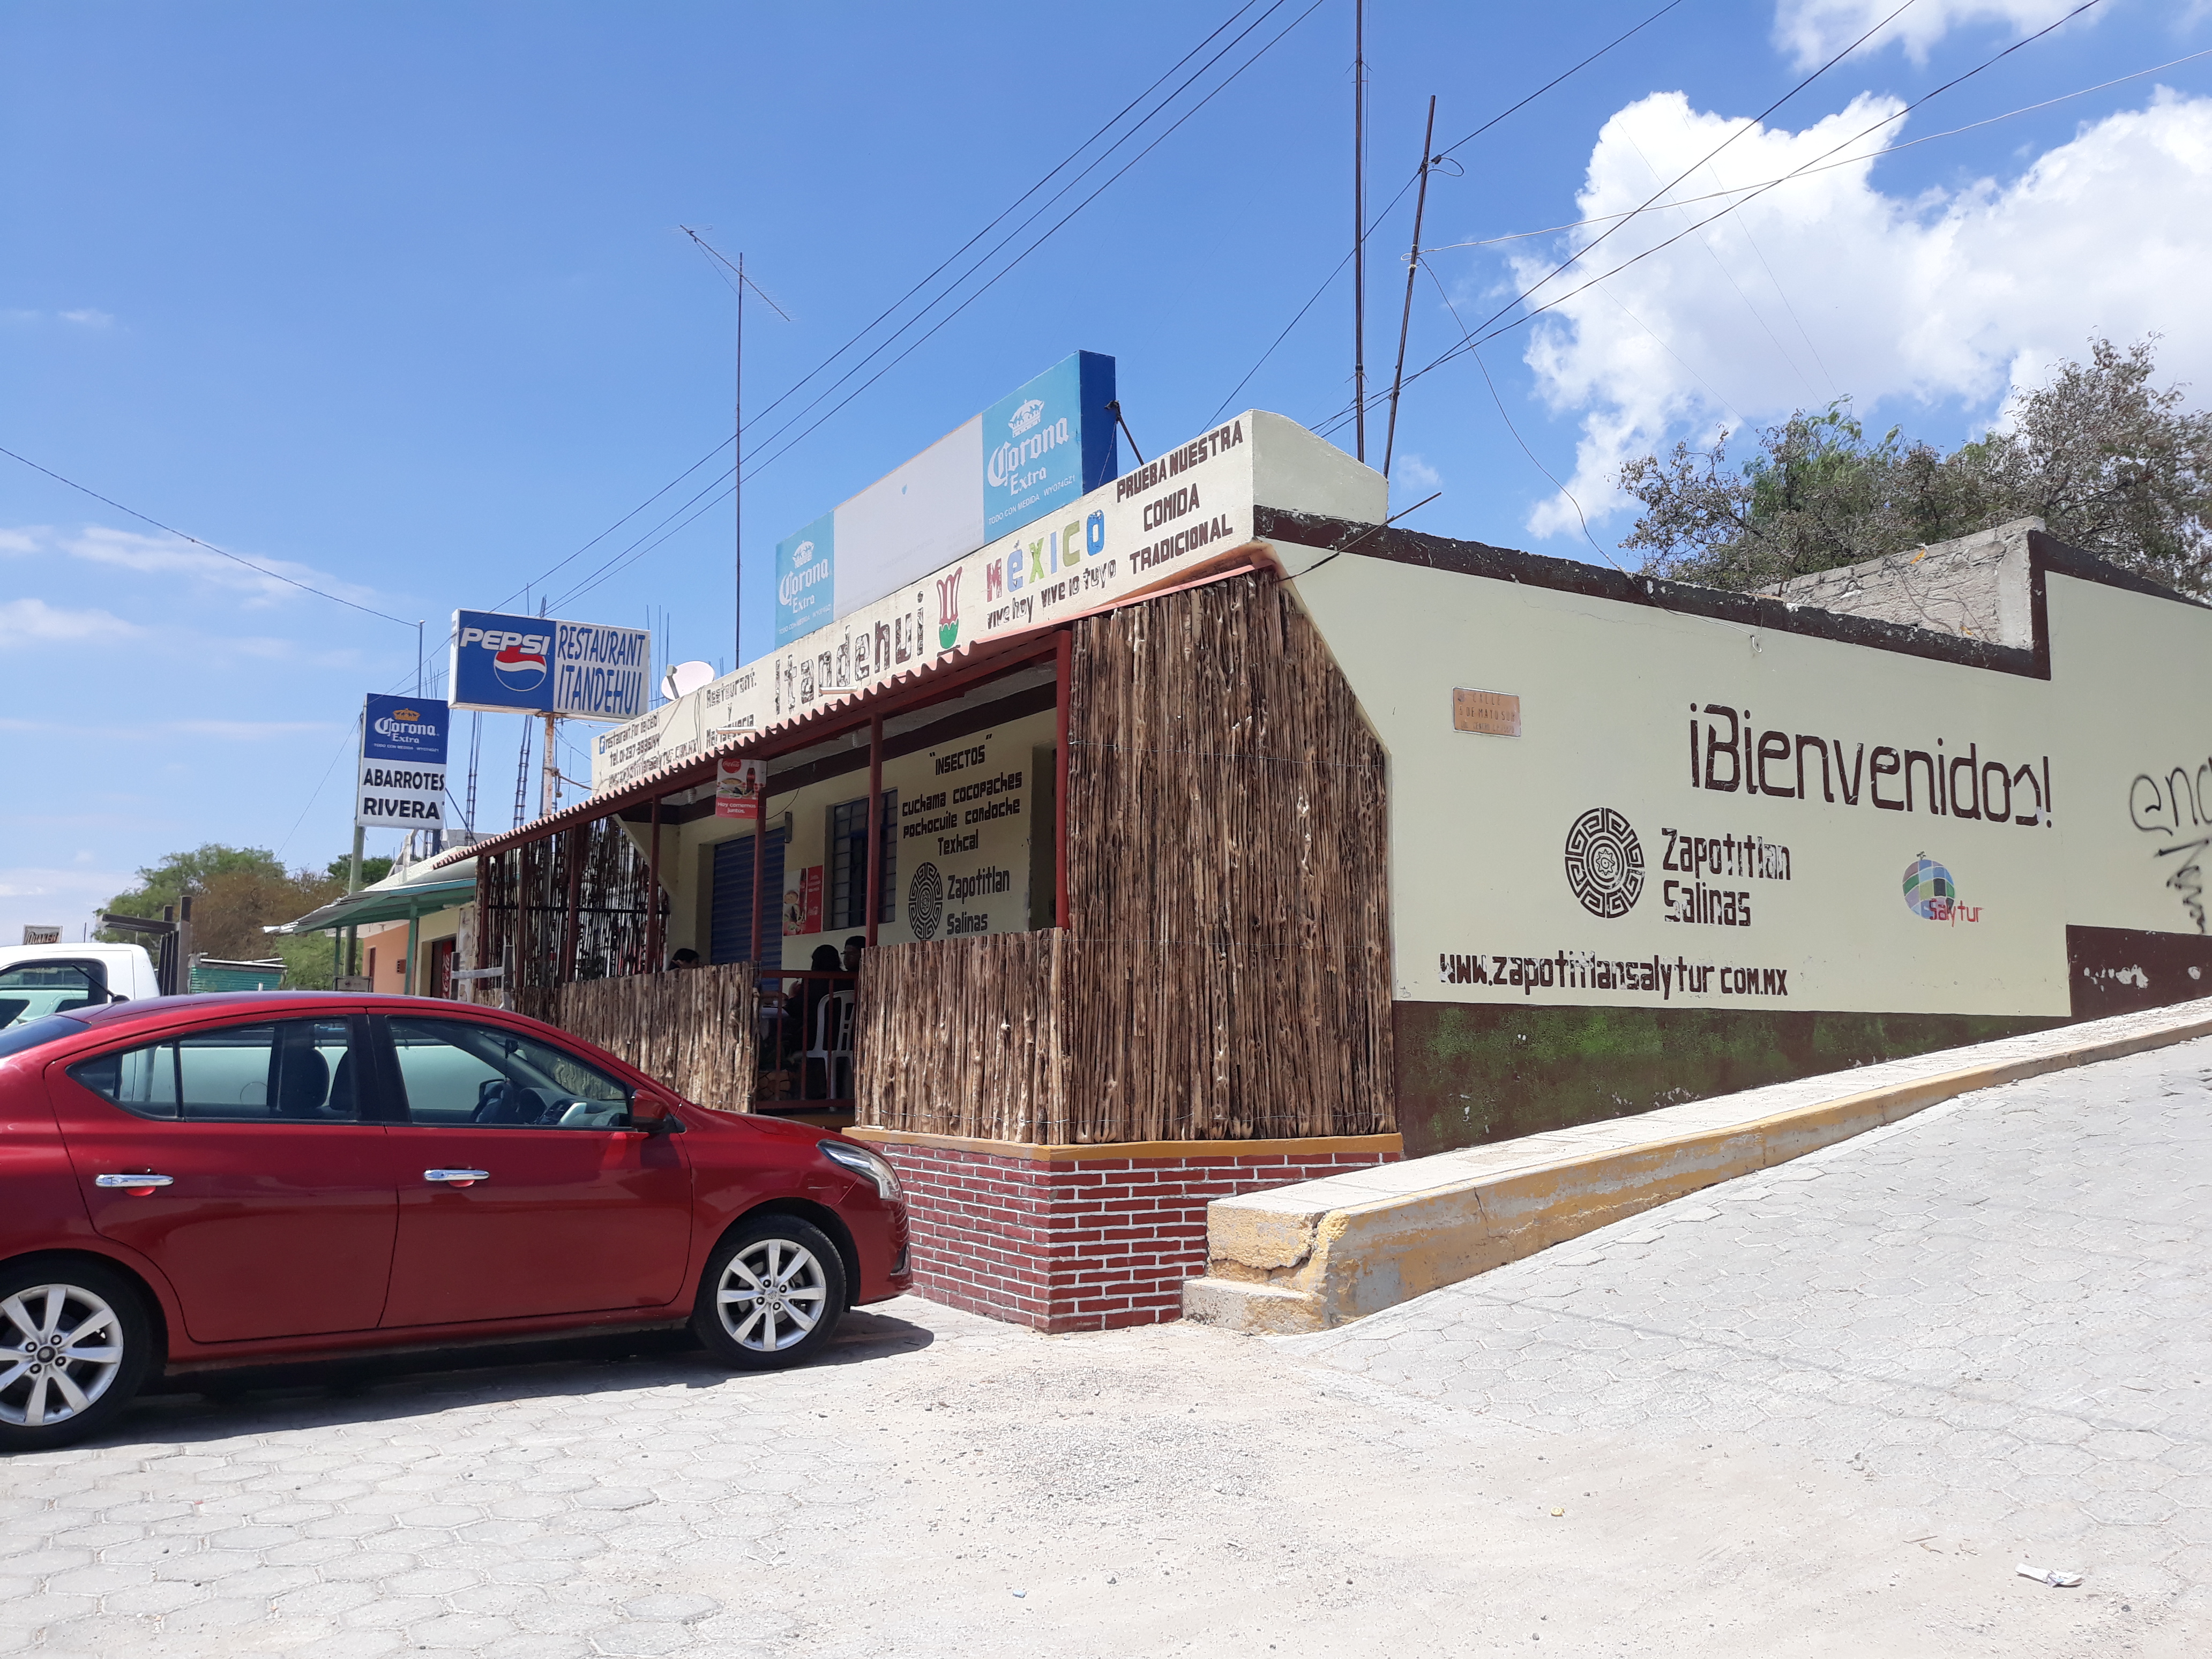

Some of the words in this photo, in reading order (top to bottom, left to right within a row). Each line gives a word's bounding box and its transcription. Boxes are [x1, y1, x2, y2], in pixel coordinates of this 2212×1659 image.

[988, 417, 1069, 488] Corona
[1117, 458, 1167, 503] PRUEBA
[1170, 420, 1243, 477] NUESTRA
[1010, 467, 1047, 496] Extra
[989, 512, 1003, 525] TODO
[1004, 505, 1017, 517] CON
[1018, 494, 1040, 510] MEDIDA
[1144, 483, 1200, 532] COMIDA
[1130, 513, 1233, 574] TRADICIONAL
[779, 558, 829, 606] Corona
[1012, 595, 1034, 623] hoy
[1083, 559, 1116, 591] tuyo
[793, 595, 815, 614] Extra
[460, 627, 551, 655] PEPSI
[558, 625, 646, 667] RESTAURANT
[775, 591, 924, 715] Itandehui
[558, 664, 642, 716] ITANDEHUI
[1473, 691, 1501, 706] CALLE
[375, 717, 437, 737] Corona
[1466, 706, 1475, 718] DE
[392, 733, 420, 744] Extra
[363, 768, 444, 791] ABARROTES
[902, 791, 946, 817] cuchama
[953, 772, 1022, 804] cocopaches
[363, 797, 440, 820] RIVERA
[903, 810, 958, 839] pochocuile
[965, 797, 1020, 825] condoche
[938, 828, 978, 856] Texhcal
[1662, 827, 1791, 880] Zapotitlan
[947, 865, 1010, 905] Zapotitlan
[1663, 880, 1751, 926] Salinas
[947, 911, 988, 935] Salinas
